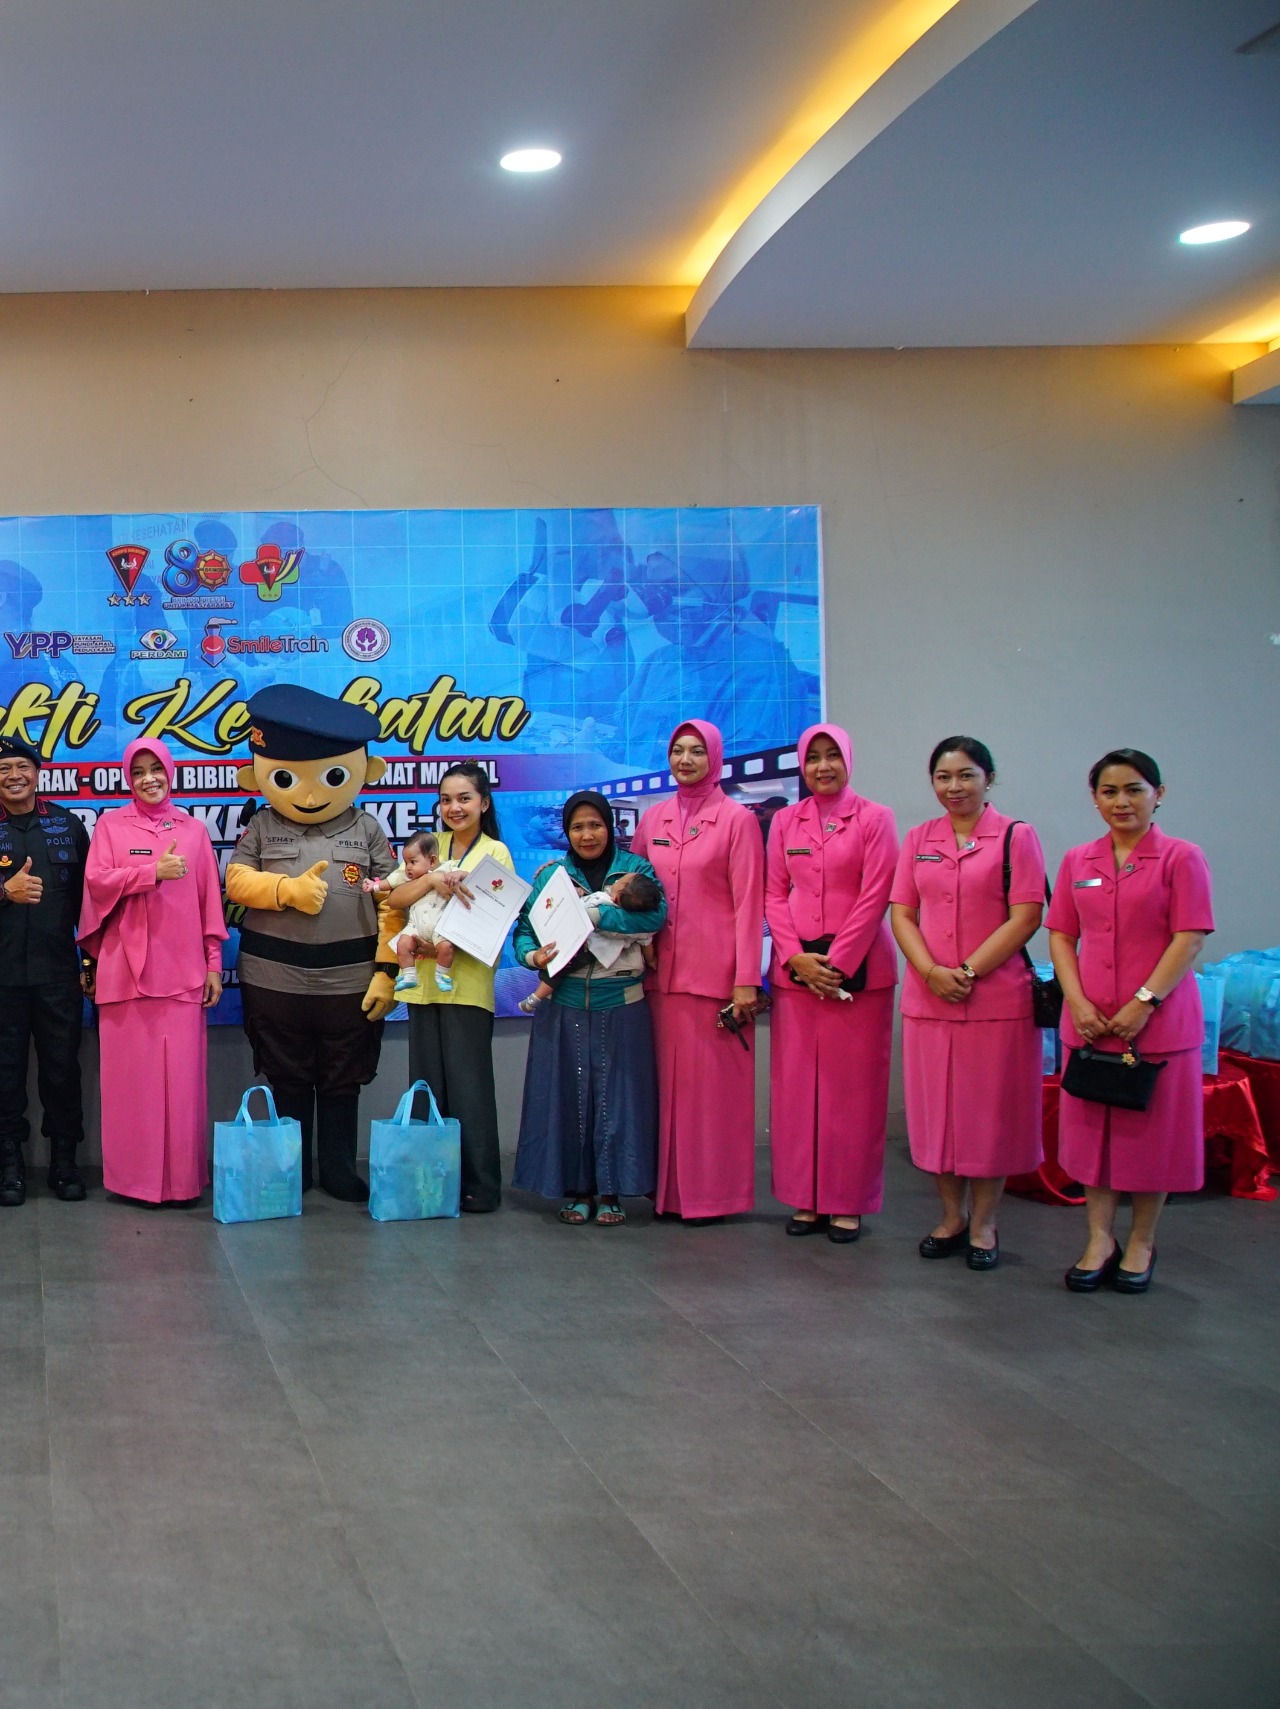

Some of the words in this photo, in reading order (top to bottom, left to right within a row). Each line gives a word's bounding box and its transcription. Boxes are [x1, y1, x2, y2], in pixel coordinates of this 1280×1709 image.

[5, 632, 72, 657] YPP
[131, 651, 187, 659] PERDAMI
[183, 765, 239, 789] BIBIR
[46, 837, 73, 846] POLRI
